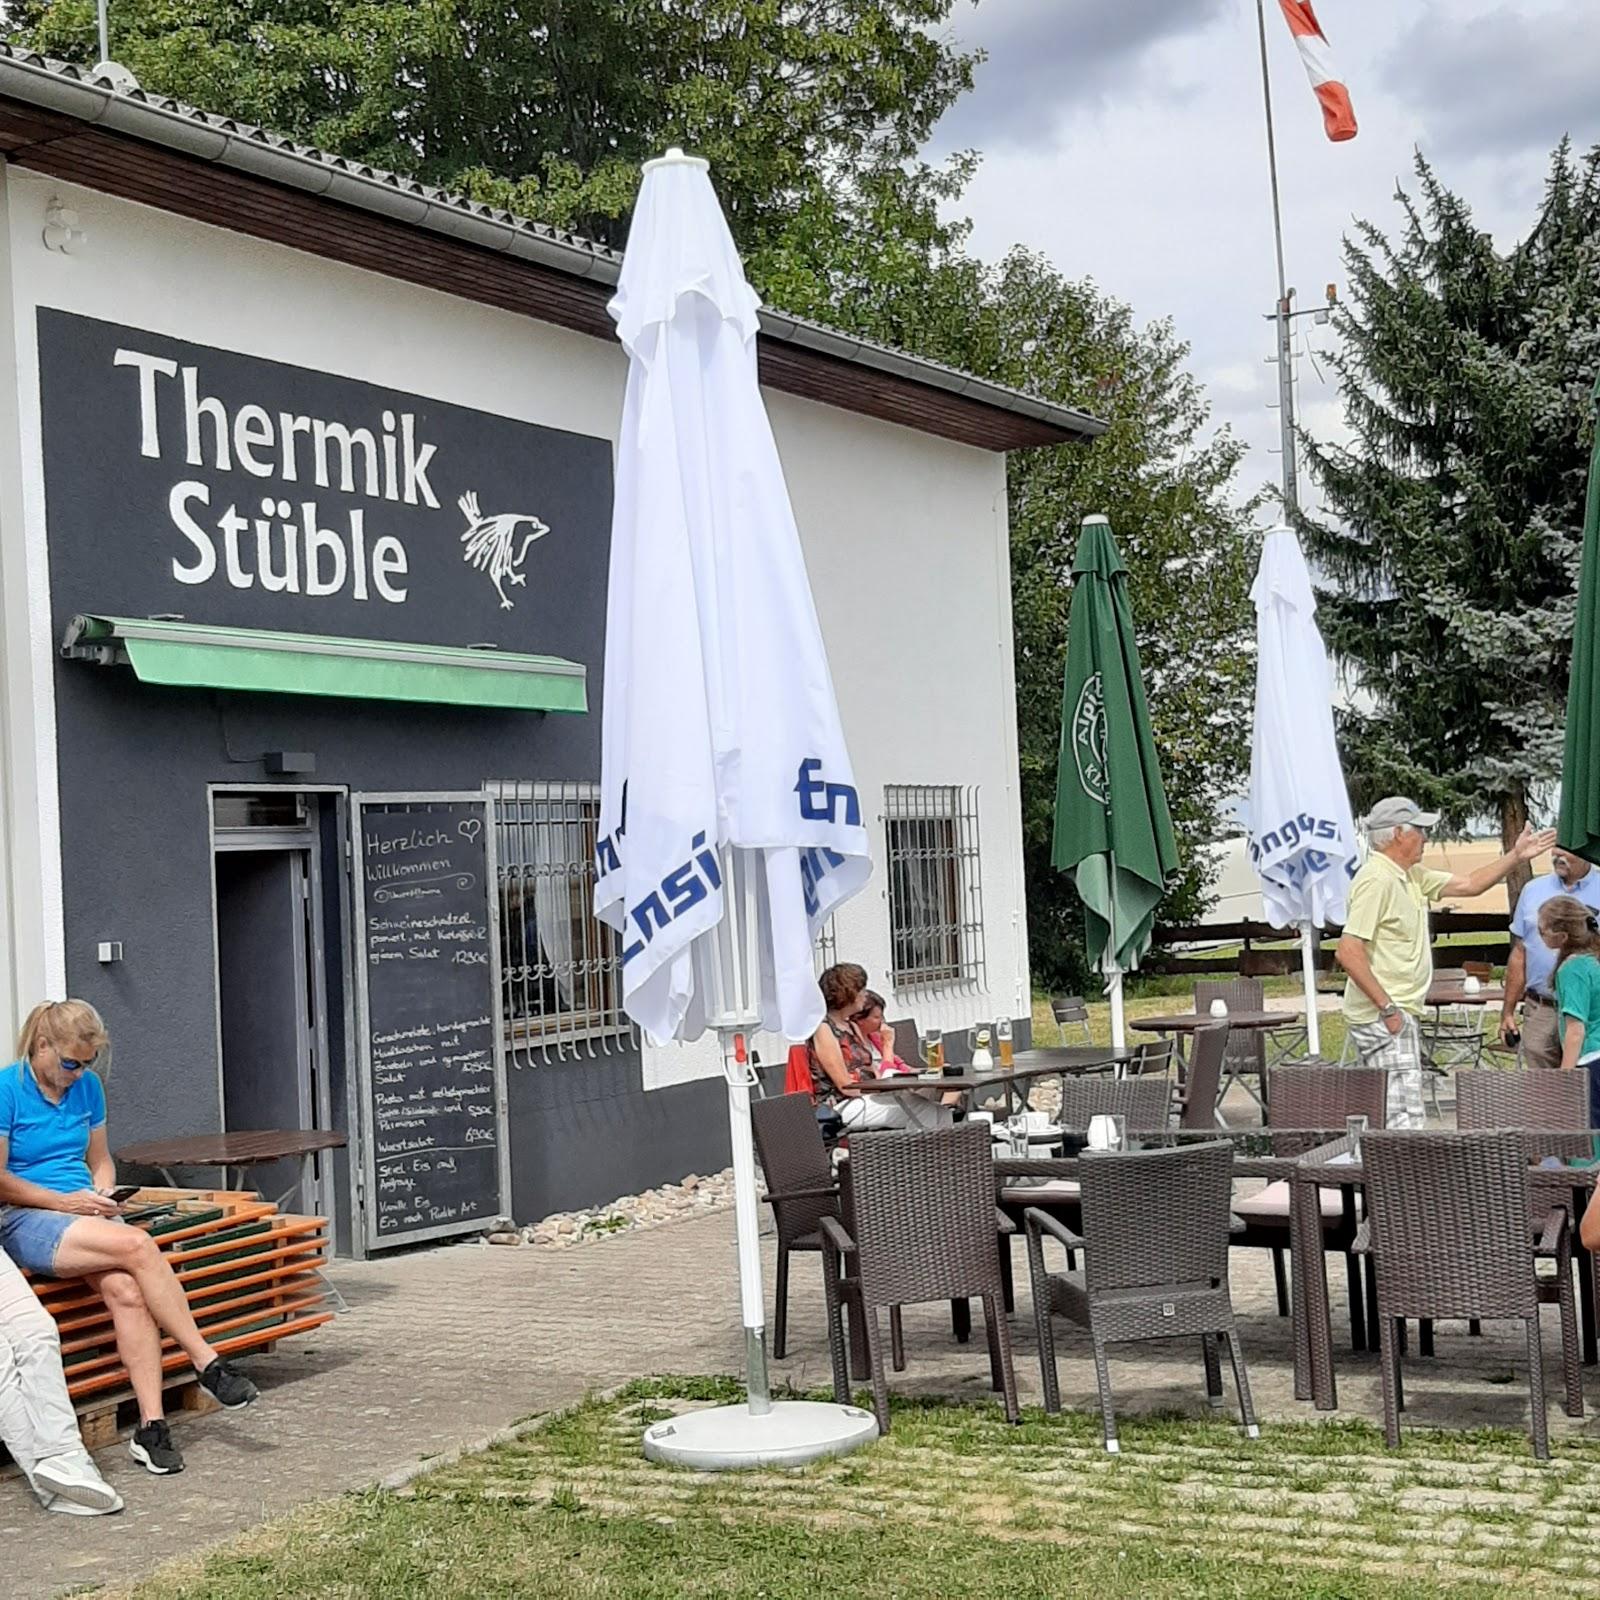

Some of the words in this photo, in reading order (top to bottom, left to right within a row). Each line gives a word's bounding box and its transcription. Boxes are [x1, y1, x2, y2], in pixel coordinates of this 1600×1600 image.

[113, 348, 441, 508] Thermik
[169, 480, 408, 603] Stüble
[367, 828, 454, 856] Herzlich
[366, 859, 452, 881] Willkommen
[408, 946, 440, 960] Salat
[441, 1034, 461, 1048] mit
[376, 1072, 406, 1085] Salat
[378, 1136, 436, 1153] Wurstsalat
